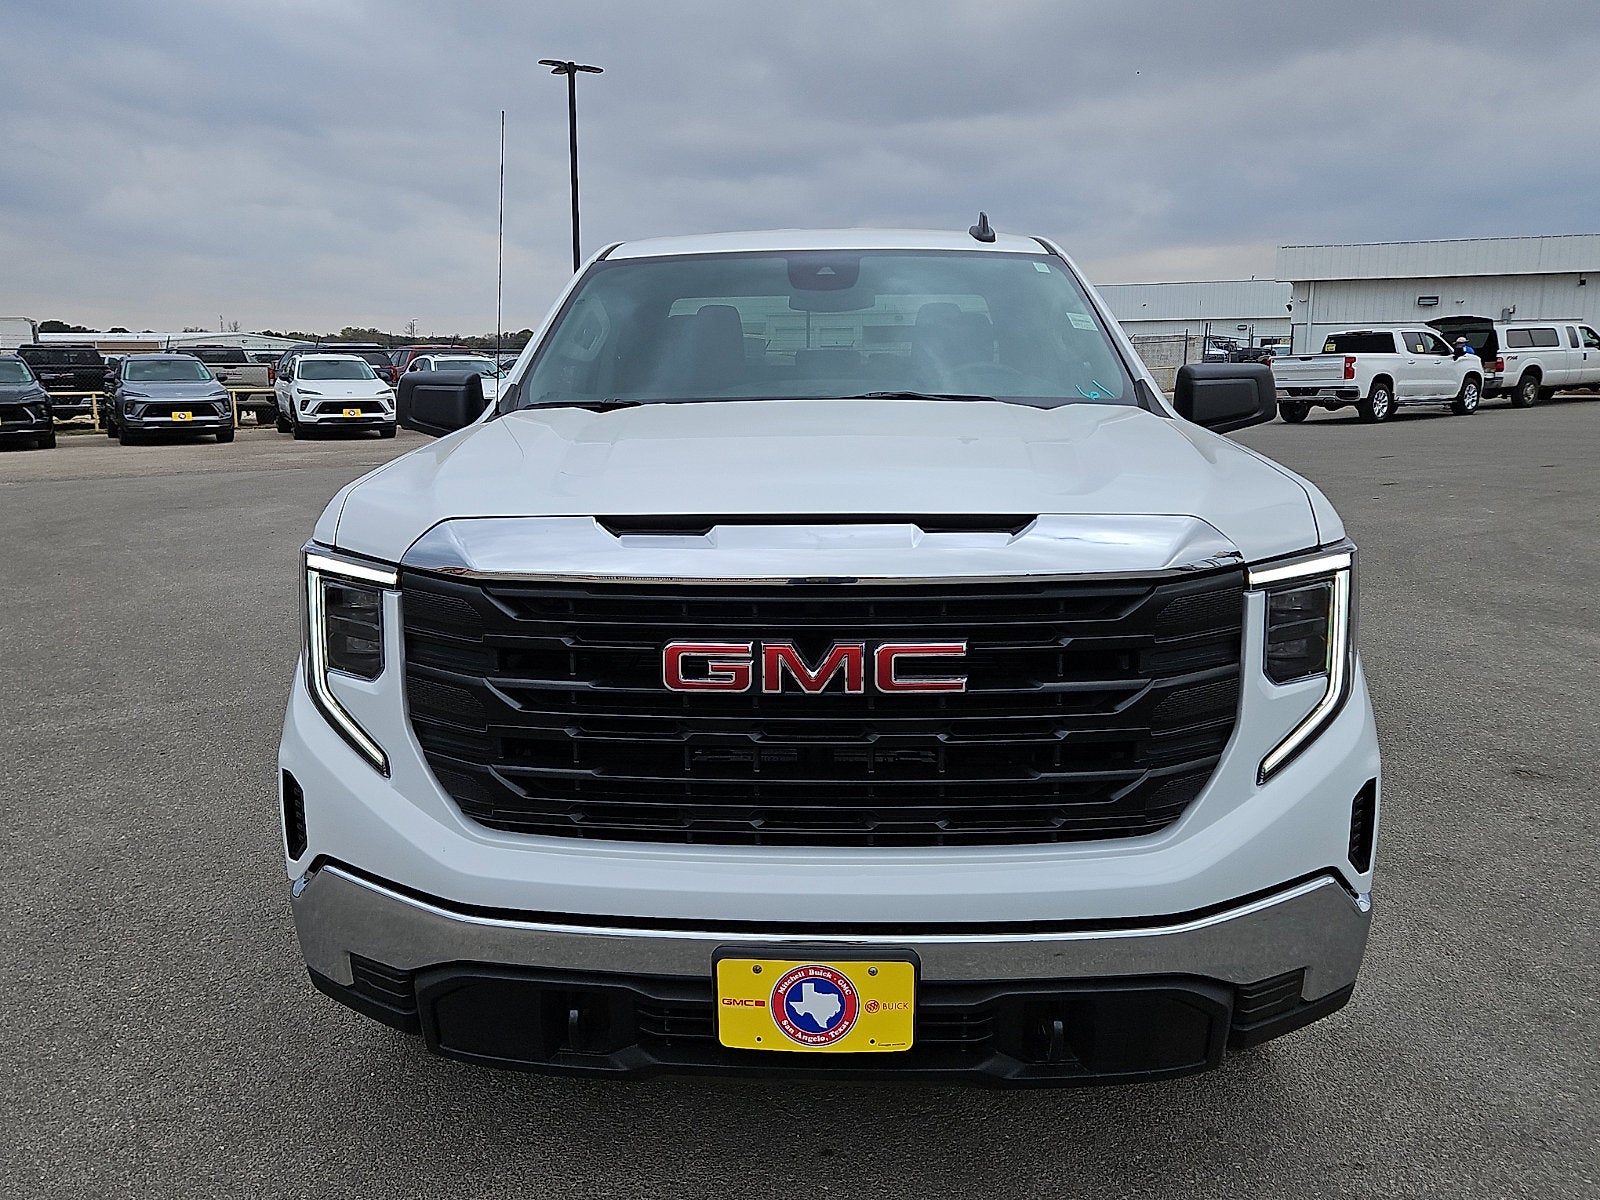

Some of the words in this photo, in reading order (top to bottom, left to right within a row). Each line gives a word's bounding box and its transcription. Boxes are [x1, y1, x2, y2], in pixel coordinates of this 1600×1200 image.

[662, 639, 968, 695] GMC
[778, 971, 805, 995] Mitchell
[808, 969, 832, 979] Buick
[837, 979, 852, 995] GMC
[722, 998, 754, 1007] GMC
[882, 1002, 909, 1010] BUICK
[781, 1019, 795, 1034] San
[795, 1032, 829, 1043] Angelo,
[828, 1020, 850, 1038] Texas
